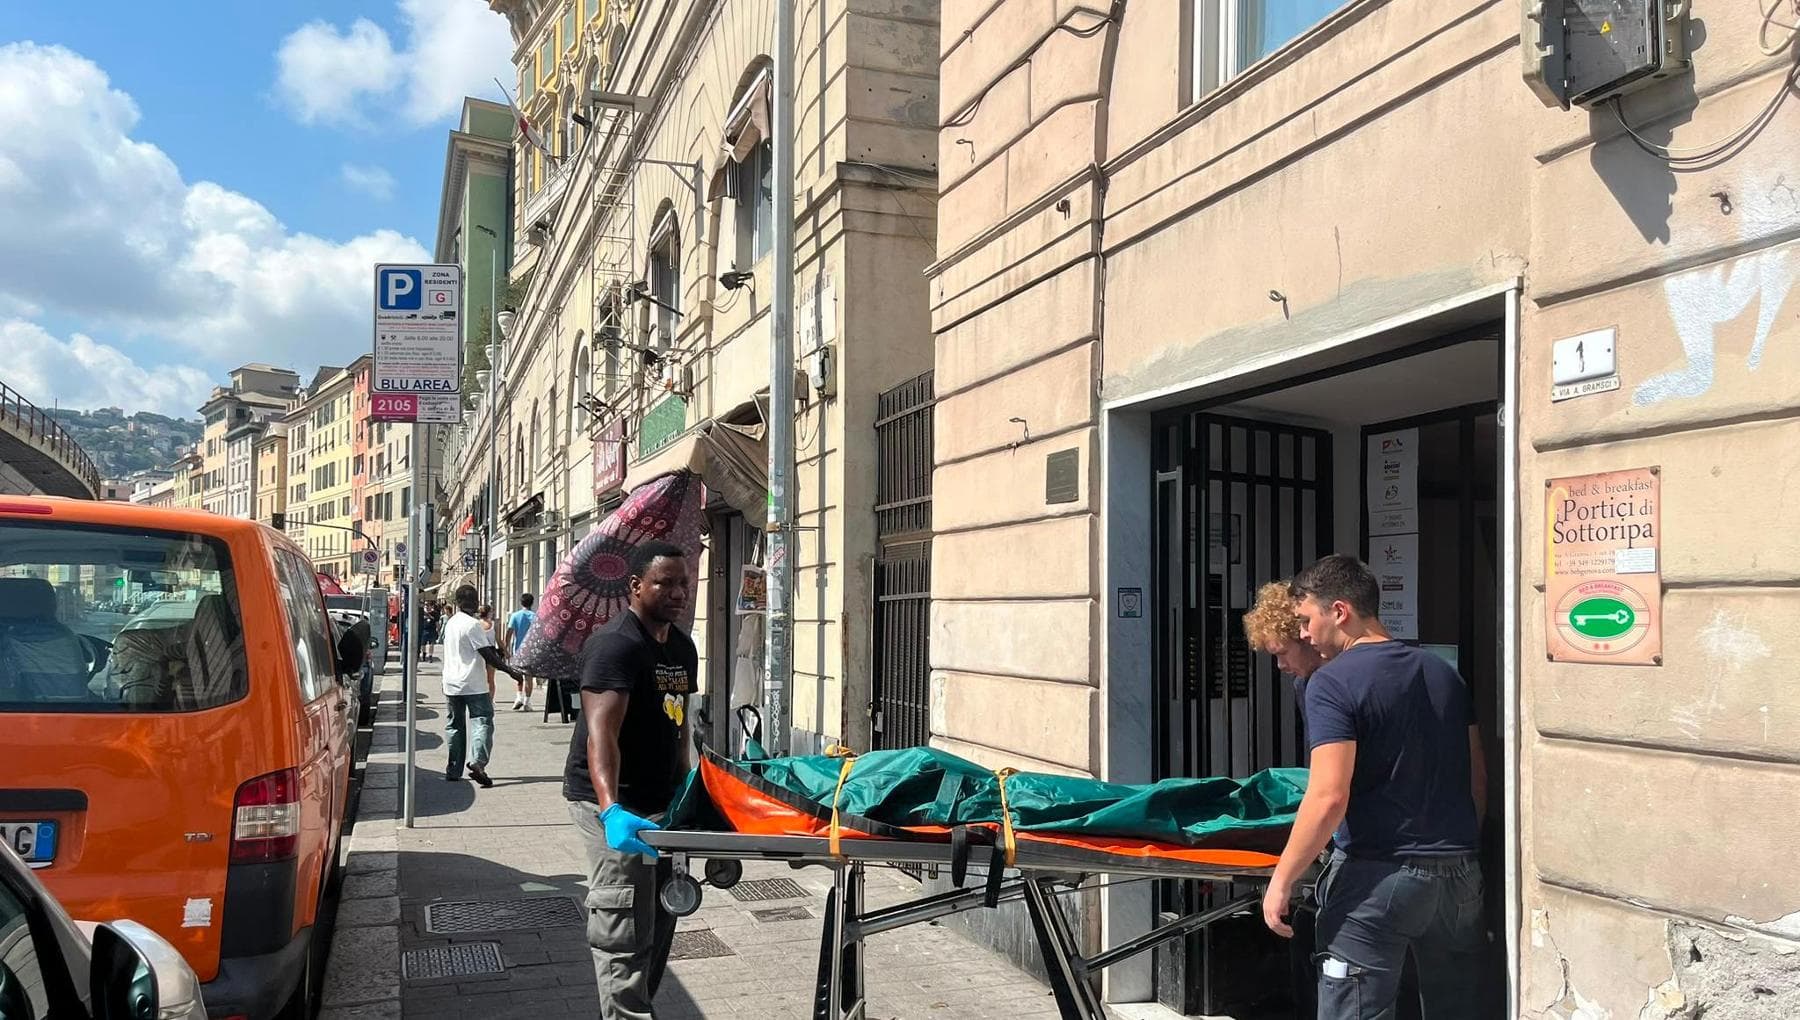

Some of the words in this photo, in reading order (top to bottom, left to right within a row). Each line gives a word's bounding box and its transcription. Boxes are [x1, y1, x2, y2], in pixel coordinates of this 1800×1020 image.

[388, 273, 414, 305] P
[436, 292, 446, 303] G
[1576, 340, 1585, 373] 1
[381, 379, 409, 389] BLU
[413, 380, 452, 390] AREA
[1560, 388, 1570, 396] VIA
[1582, 380, 1612, 393] GRAMSCI
[378, 400, 411, 411] 2105
[1568, 484, 1587, 497] bed
[1591, 484, 1601, 495] &
[1605, 478, 1653, 494] breakfast
[1563, 494, 1634, 522] Portici
[1639, 499, 1653, 516] di
[1553, 518, 1654, 549] Sottoripa
[0, 826, 32, 855] G
[184, 832, 213, 841] TDI
